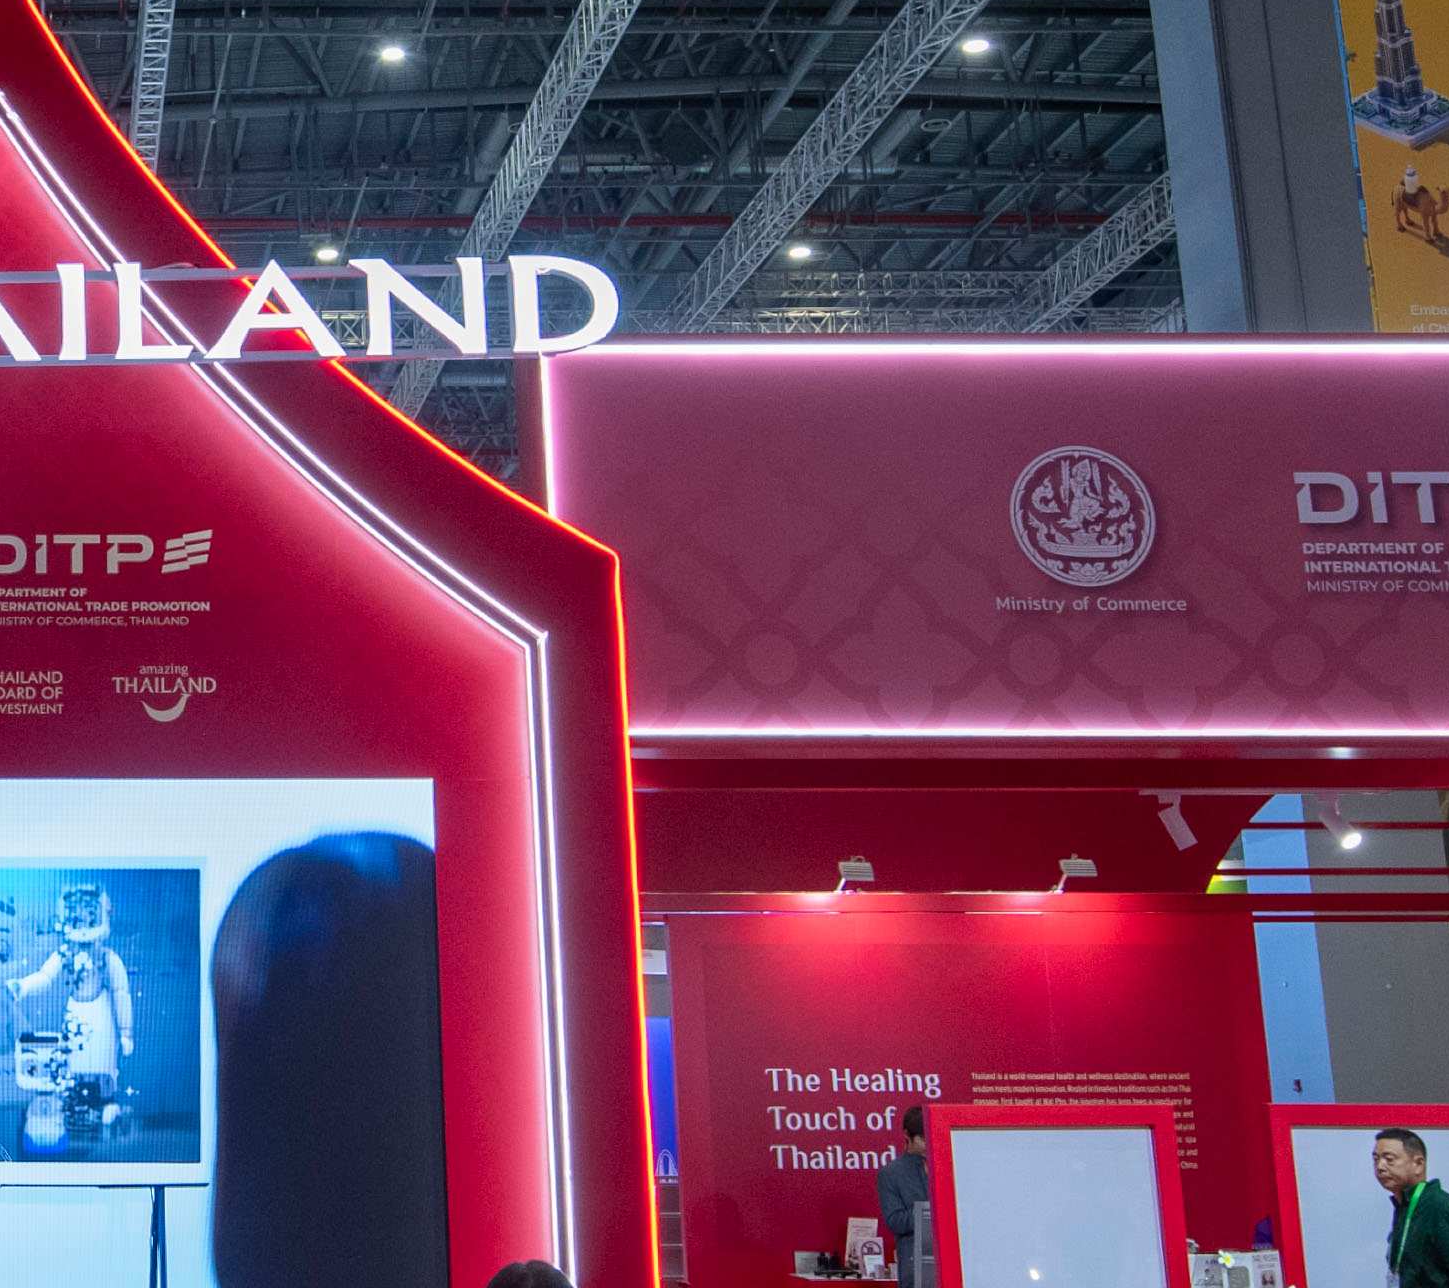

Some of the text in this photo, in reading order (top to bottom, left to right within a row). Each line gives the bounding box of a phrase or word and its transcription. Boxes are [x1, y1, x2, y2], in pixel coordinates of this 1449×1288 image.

[1302, 542, 1445, 555] DEPARTMENT OF
[1304, 560, 1440, 574] INTERNATIONAL
[69, 587, 89, 598] OF
[1307, 580, 1378, 593] MINISTRY
[1380, 580, 1405, 593] OF
[85, 601, 128, 612] TRADE
[131, 601, 211, 612] PROMOTION
[995, 596, 1187, 614] Ministry of Commerce
[37, 615, 55, 626] OF
[56, 615, 128, 627] COMMERCE,
[129, 615, 190, 626] THAILAND
[138, 664, 190, 677] amazing
[111, 676, 218, 695] THAILAND
[40, 686, 64, 700] OF
[765, 1067, 942, 1099] The Healing
[767, 1106, 898, 1131] Touch of
[770, 1145, 897, 1170] Thailand
